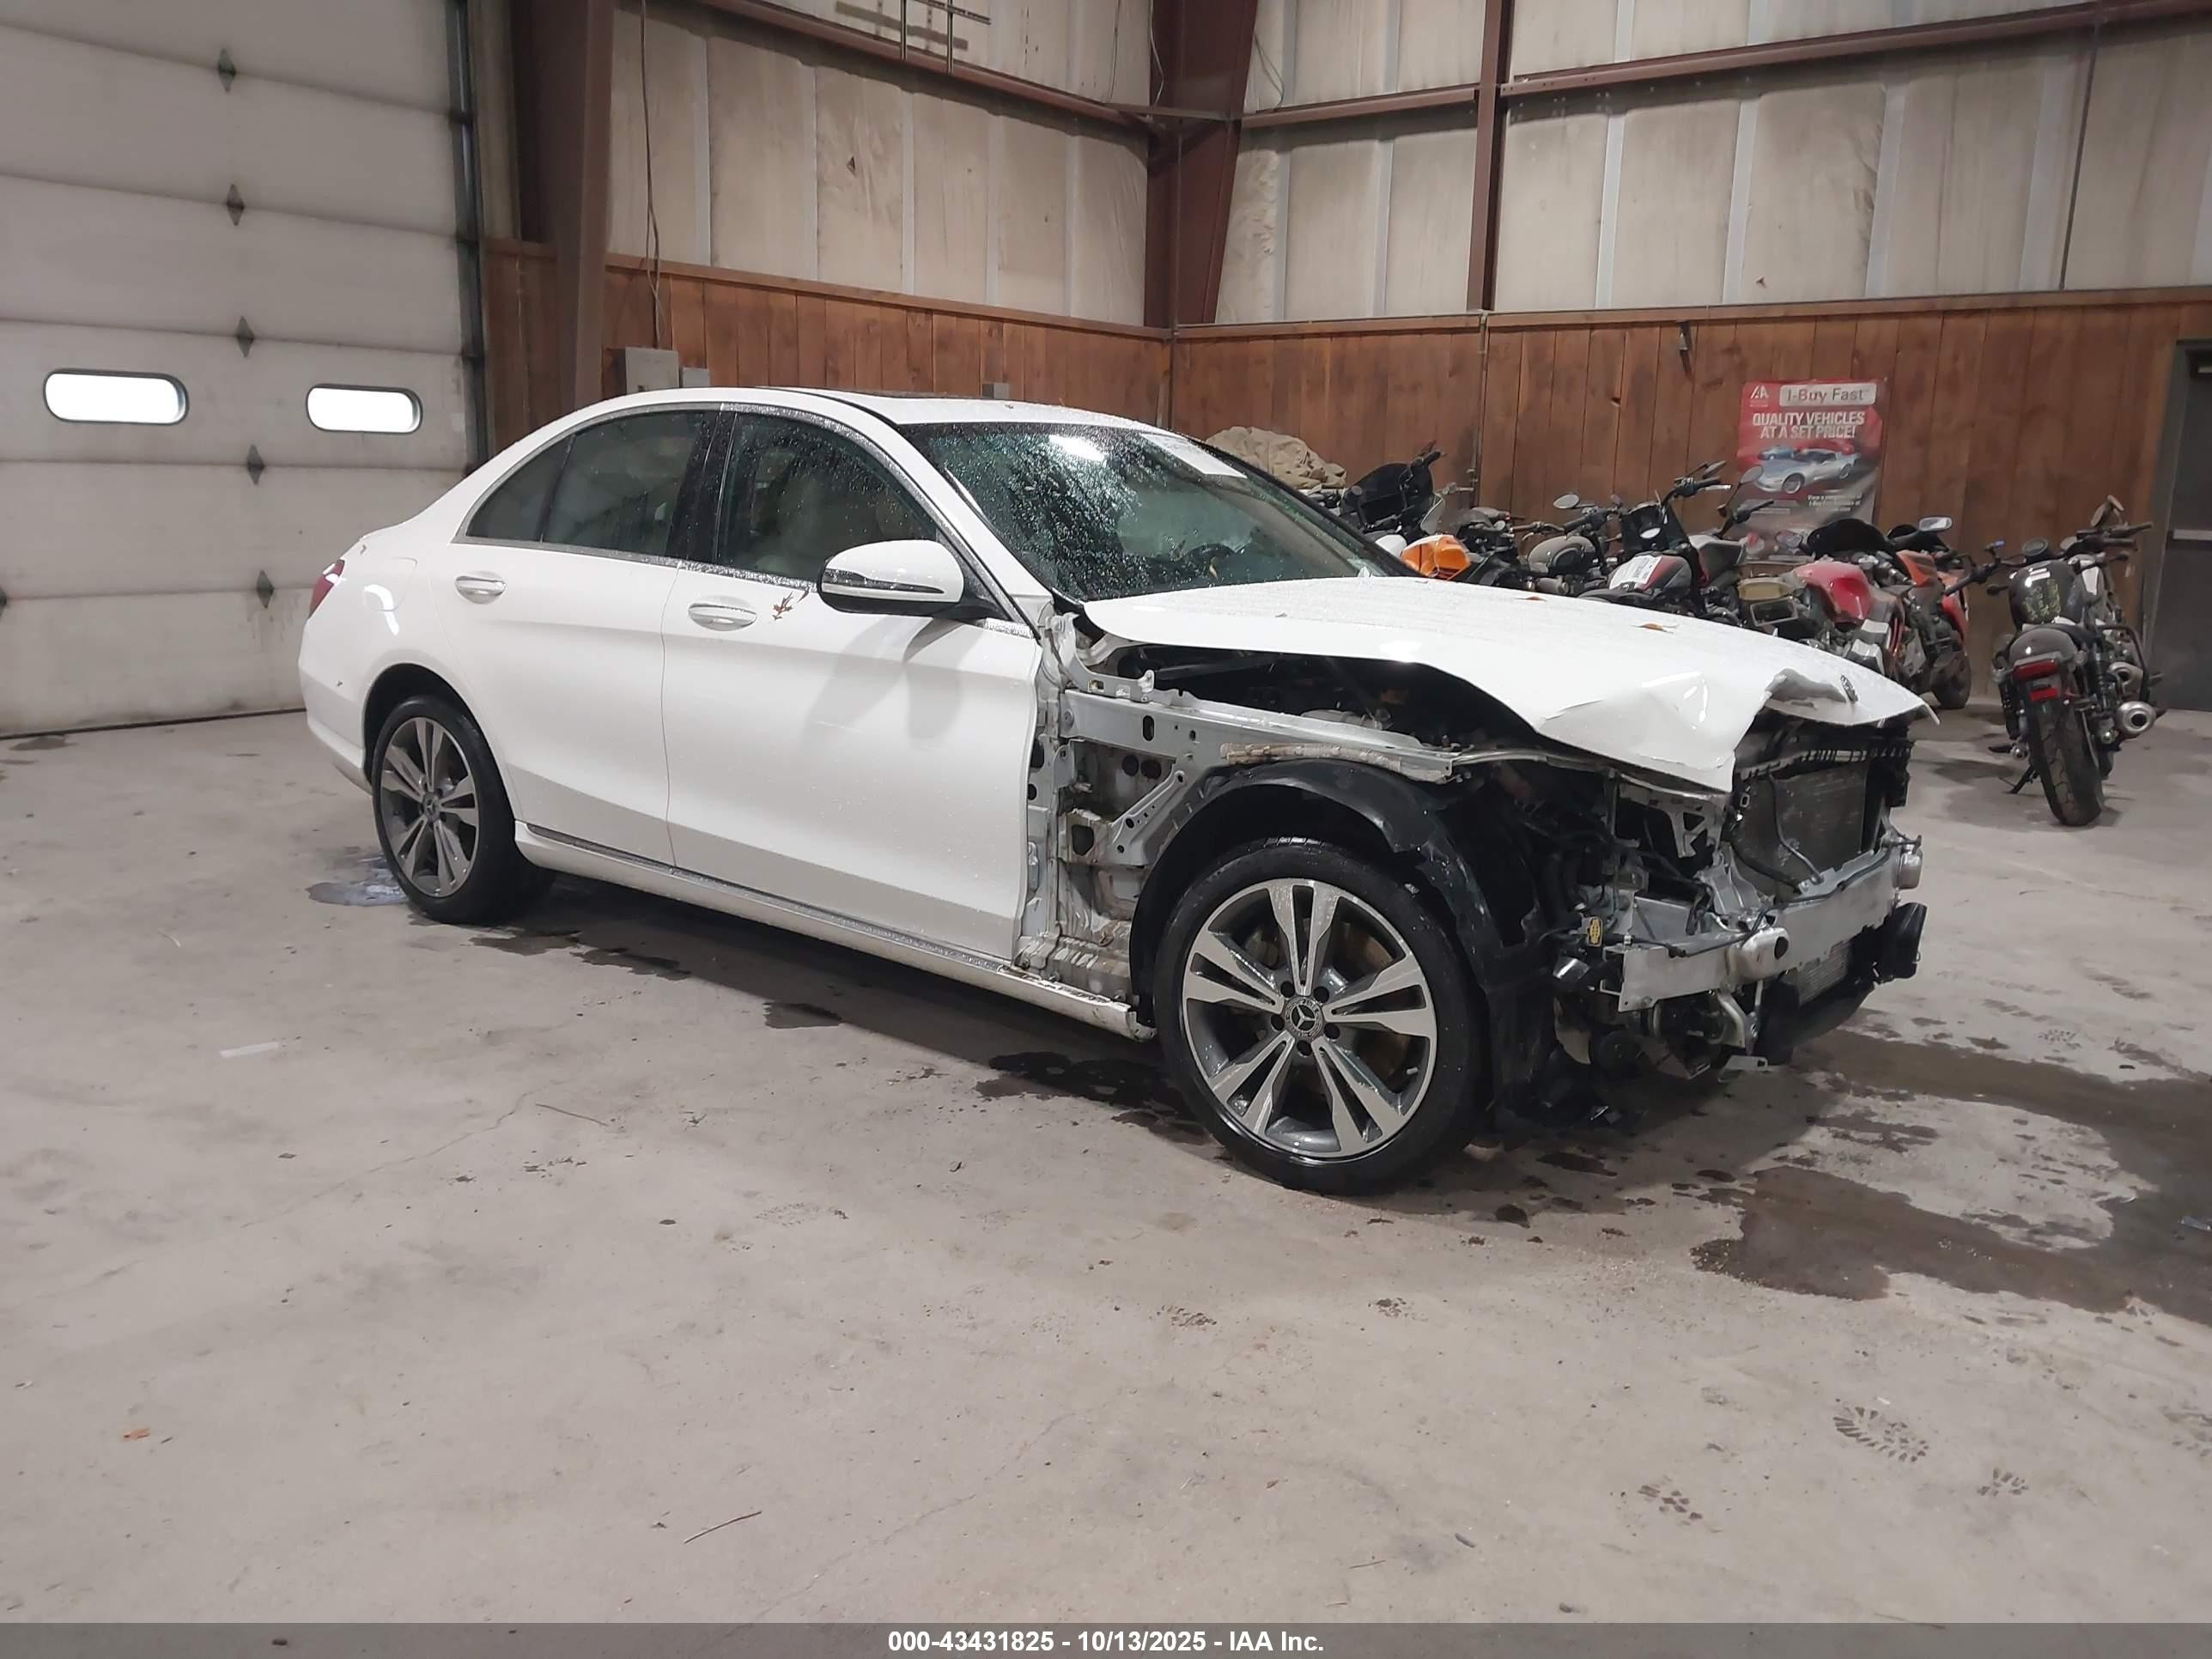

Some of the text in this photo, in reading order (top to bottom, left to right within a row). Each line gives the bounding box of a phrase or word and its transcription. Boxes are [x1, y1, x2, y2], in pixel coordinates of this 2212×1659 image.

[1788, 388, 1826, 404] I-Buy
[1753, 411, 1865, 426] QUALITY VEHICLES
[1760, 424, 1857, 439] AT A SET PRICE!
